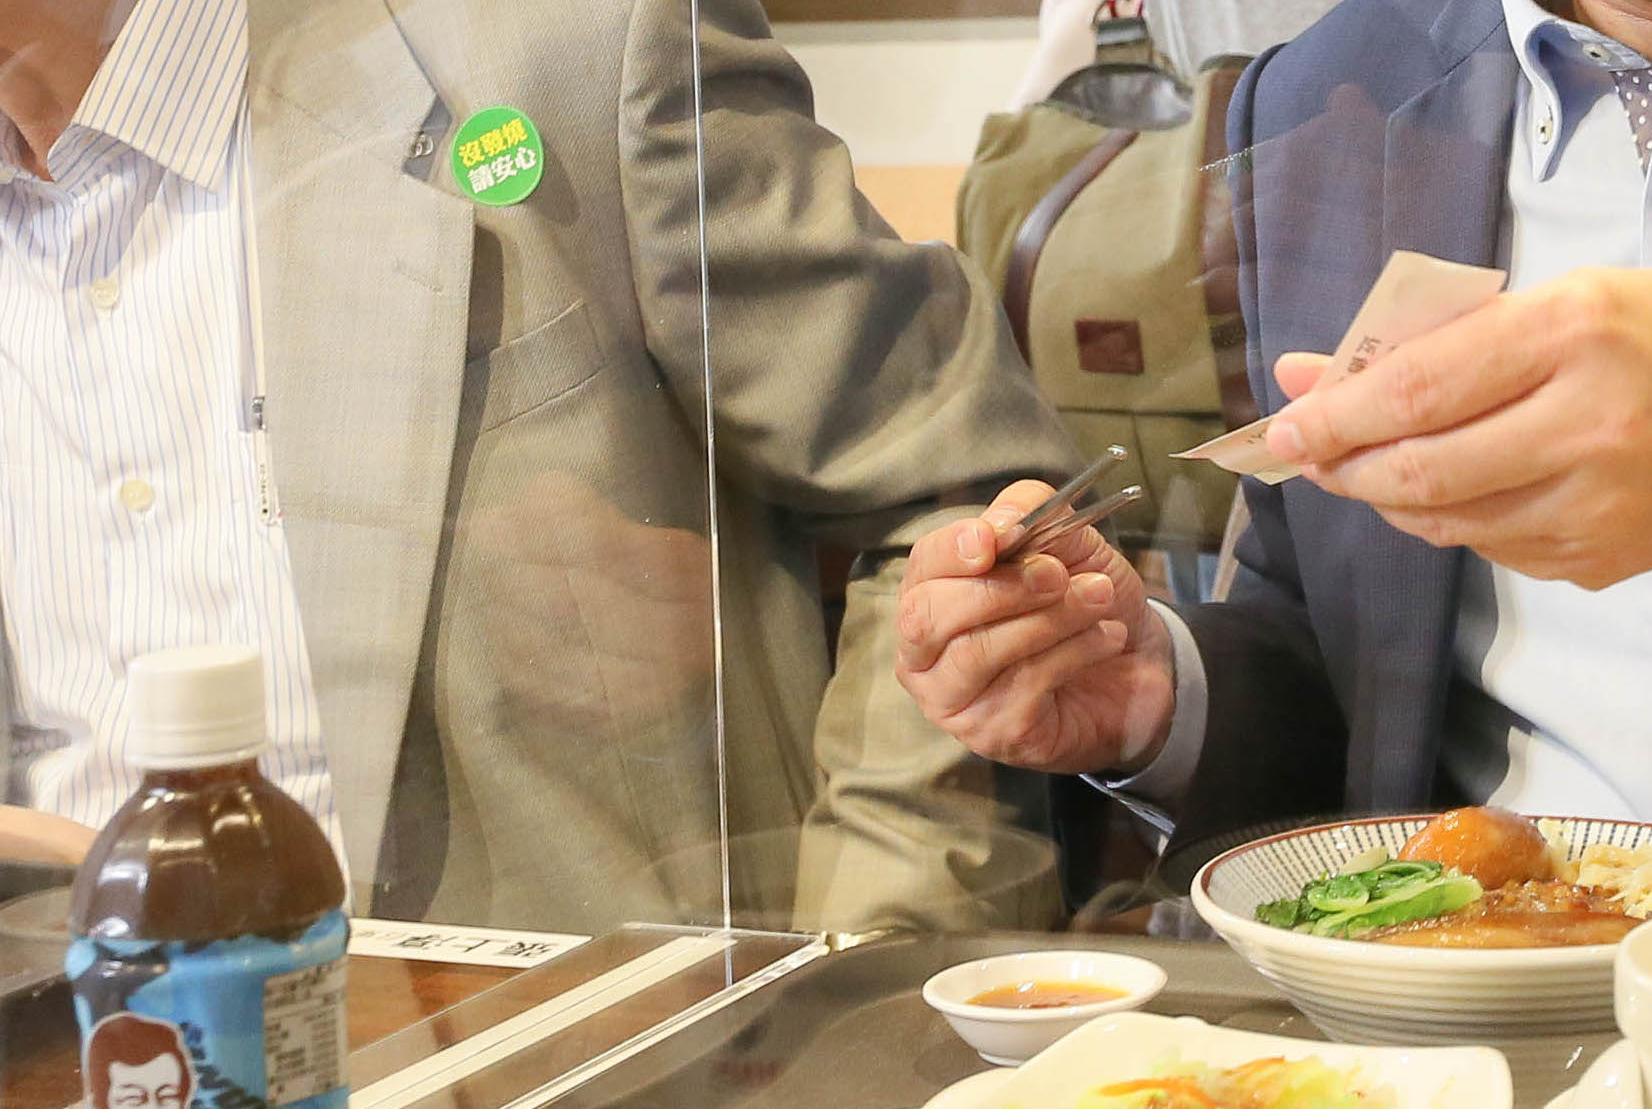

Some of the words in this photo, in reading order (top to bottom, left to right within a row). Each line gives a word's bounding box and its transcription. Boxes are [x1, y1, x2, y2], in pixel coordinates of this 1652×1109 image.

[458, 117, 528, 168] 沒發燒
[467, 146, 537, 194] 請安心
